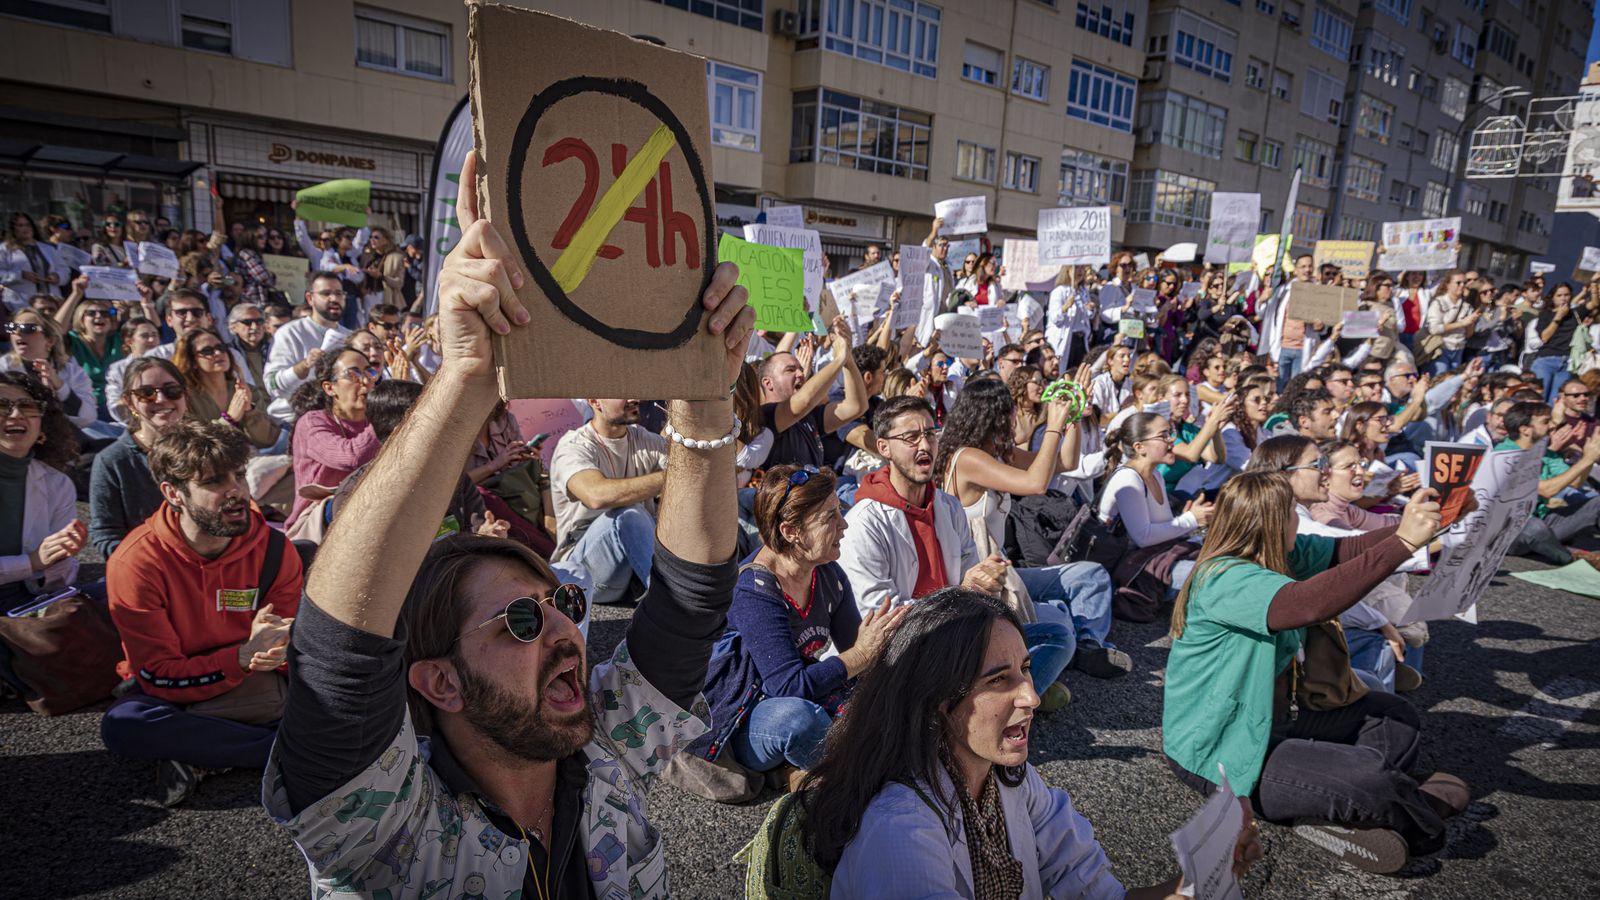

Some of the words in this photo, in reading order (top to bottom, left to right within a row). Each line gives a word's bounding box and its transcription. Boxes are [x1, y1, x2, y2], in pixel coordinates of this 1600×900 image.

[295, 149, 376, 170] DONPANES
[542, 137, 701, 270] 24h
[762, 275, 793, 302] ES
[1434, 453, 1465, 483] SE
